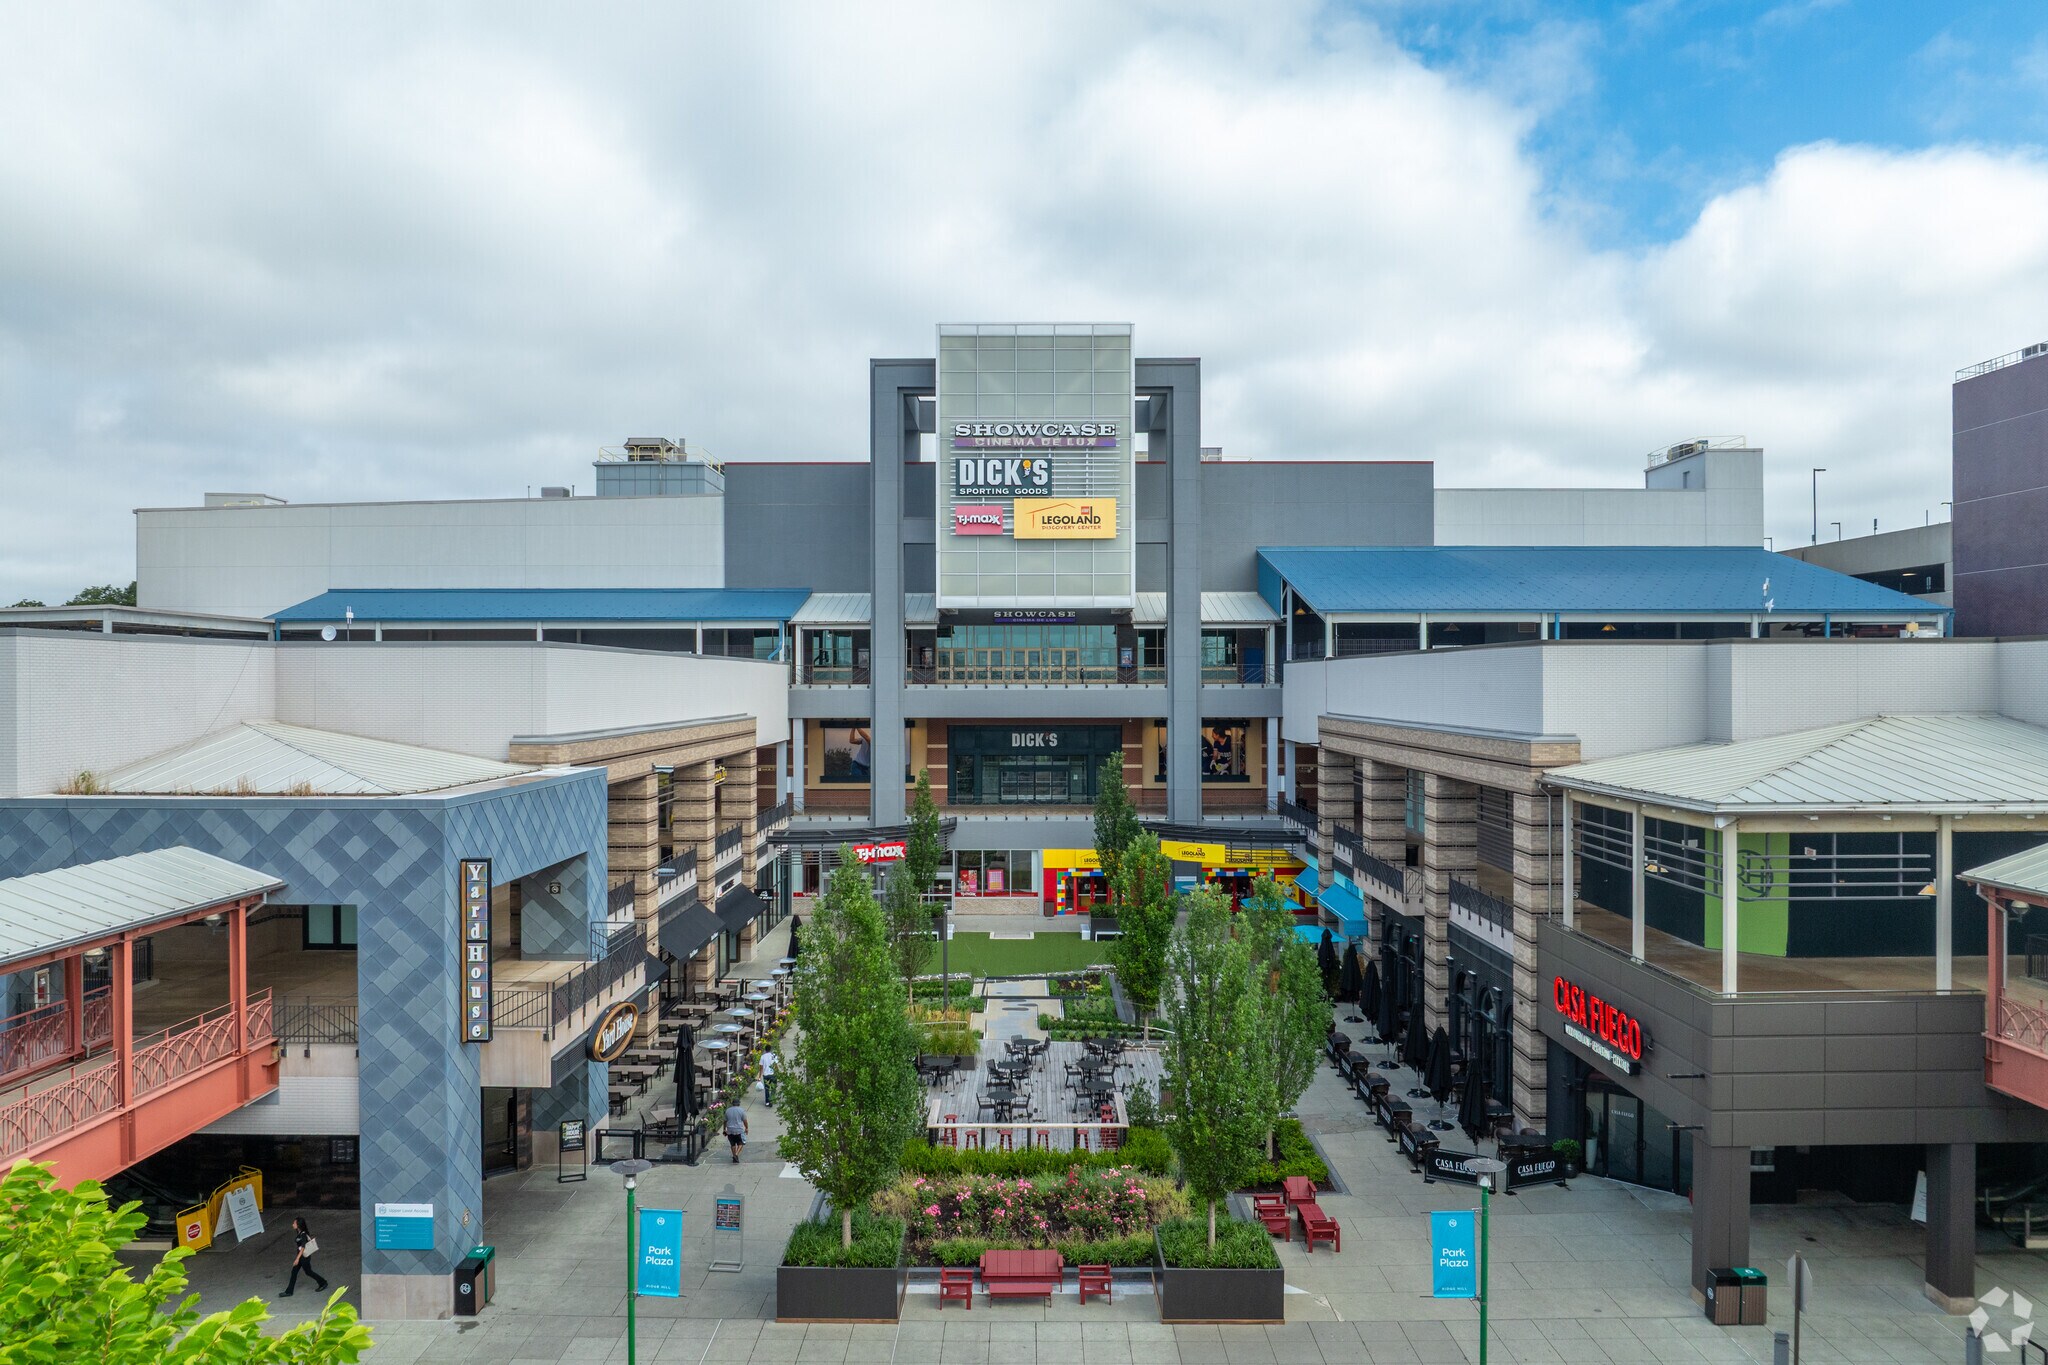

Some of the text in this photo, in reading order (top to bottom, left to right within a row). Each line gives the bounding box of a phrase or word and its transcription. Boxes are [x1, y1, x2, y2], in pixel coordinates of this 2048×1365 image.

[955, 423, 1117, 437] SHOWCASE
[975, 437, 1098, 446] CINEMA DE LUX
[959, 459, 1049, 486] DICK'S
[1042, 508, 1102, 525] LEGOLAND
[993, 610, 1077, 618] SHOWCASE
[1011, 732, 1058, 747] DICK'S
[468, 864, 484, 1037] Yard House
[1553, 975, 1588, 1029] CASA
[1590, 995, 1642, 1060] FUEGO
[602, 1022, 616, 1053] Yard
[1435, 1158, 1454, 1169] CASA
[1517, 1164, 1534, 1174] CASA
[1534, 1160, 1556, 1173] FUEGO
[648, 1245, 672, 1255] Park
[1442, 1247, 1466, 1257] Park
[645, 1256, 674, 1266] Plaza
[1439, 1258, 1469, 1268] Plaza
